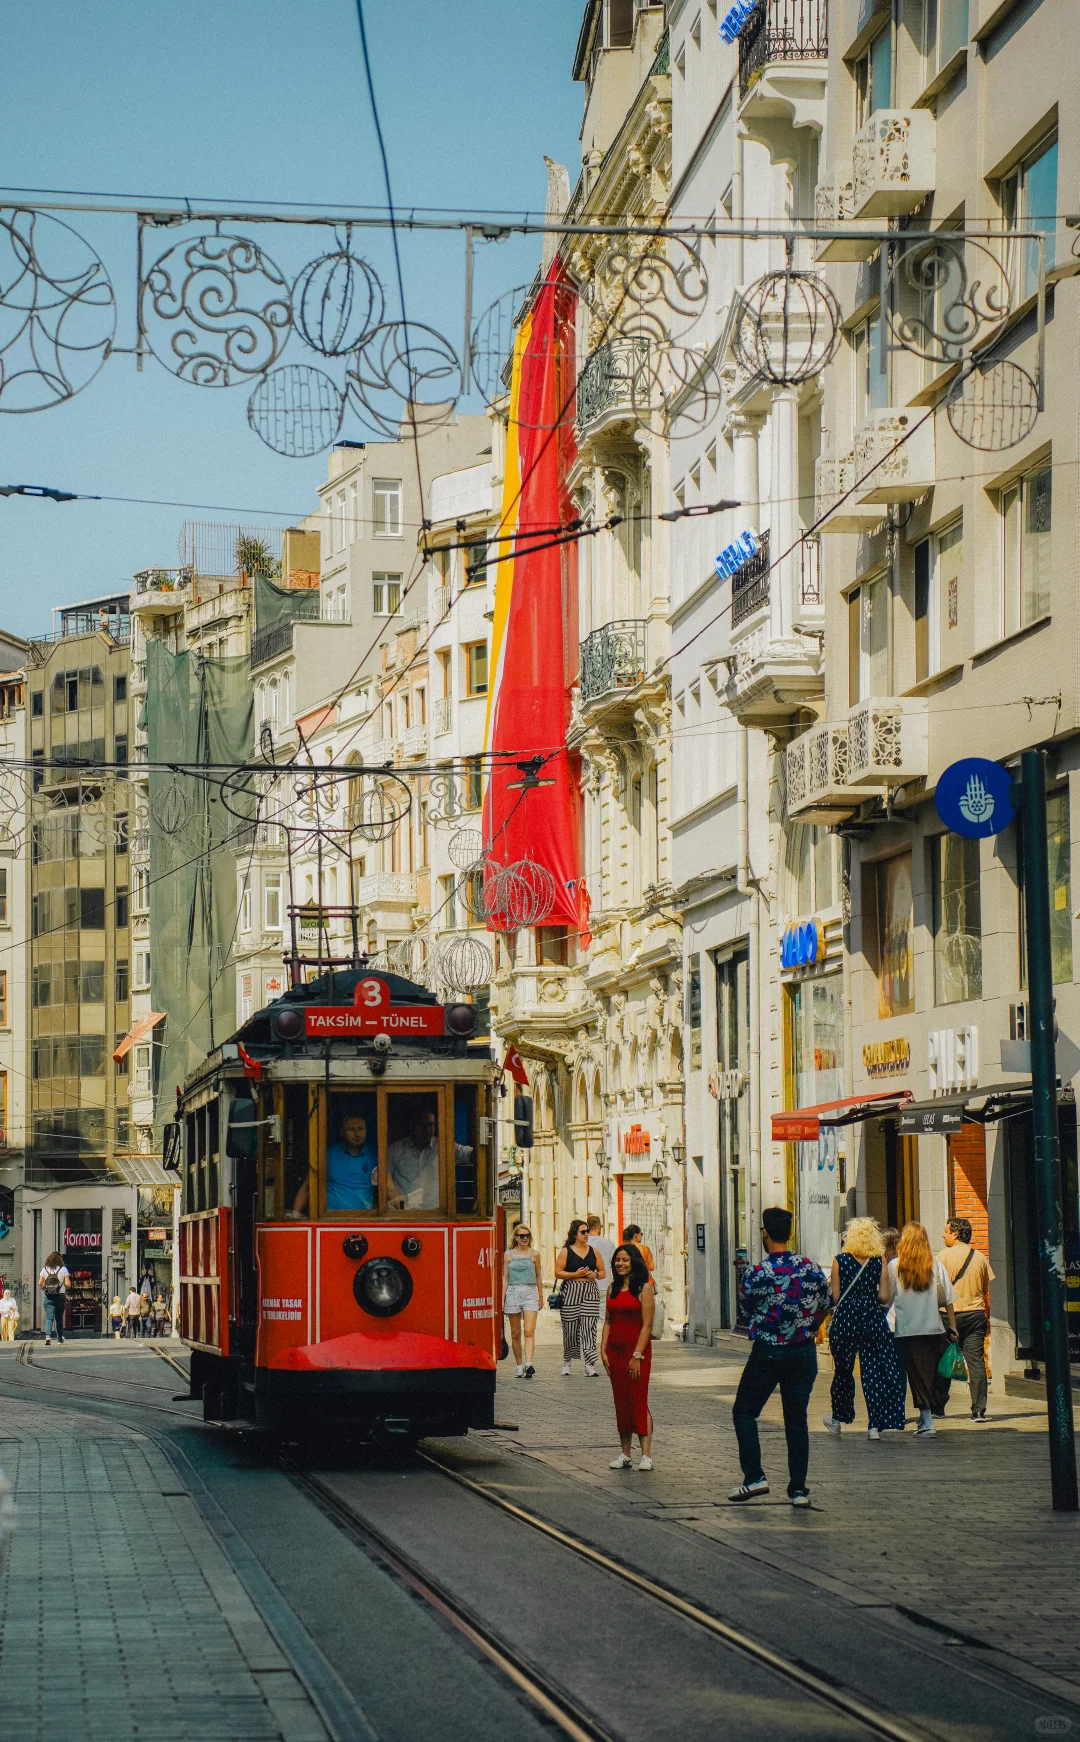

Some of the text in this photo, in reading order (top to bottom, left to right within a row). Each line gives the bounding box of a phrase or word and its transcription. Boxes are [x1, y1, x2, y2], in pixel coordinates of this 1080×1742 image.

[714, 530, 757, 580] TERAS
[363, 980, 382, 1007] 3
[308, 1013, 361, 1027] TAKSİM
[381, 1014, 428, 1028] TÜNEL
[63, 1227, 103, 1246] flormar
[282, 1298, 302, 1308] YASAK
